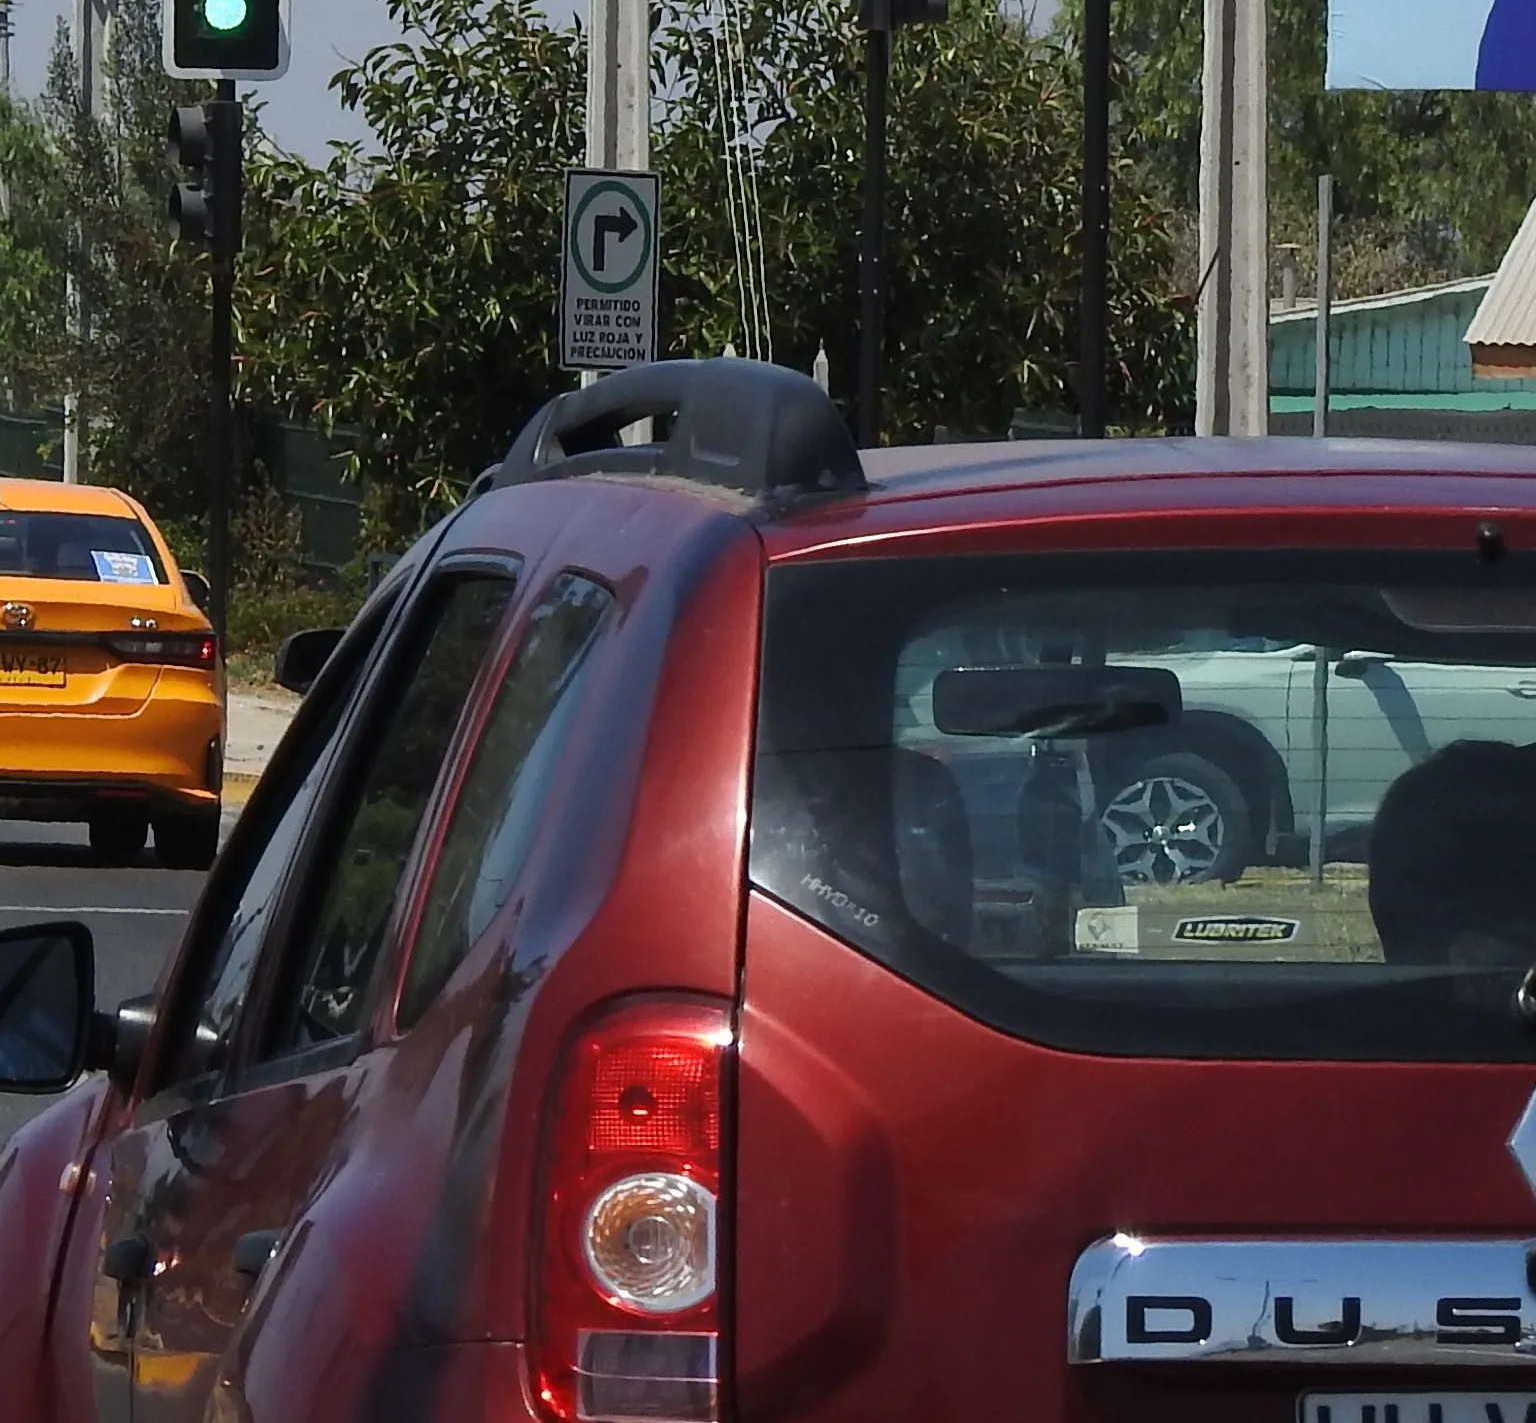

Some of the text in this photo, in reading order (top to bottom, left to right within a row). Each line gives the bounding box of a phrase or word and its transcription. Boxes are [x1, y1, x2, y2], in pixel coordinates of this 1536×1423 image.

[576, 298, 641, 312] PERMITIDO
[574, 314, 641, 327] VIRAR CON
[573, 331, 643, 344] LUZ ROJA Y
[570, 346, 645, 360] PRECAUCION
